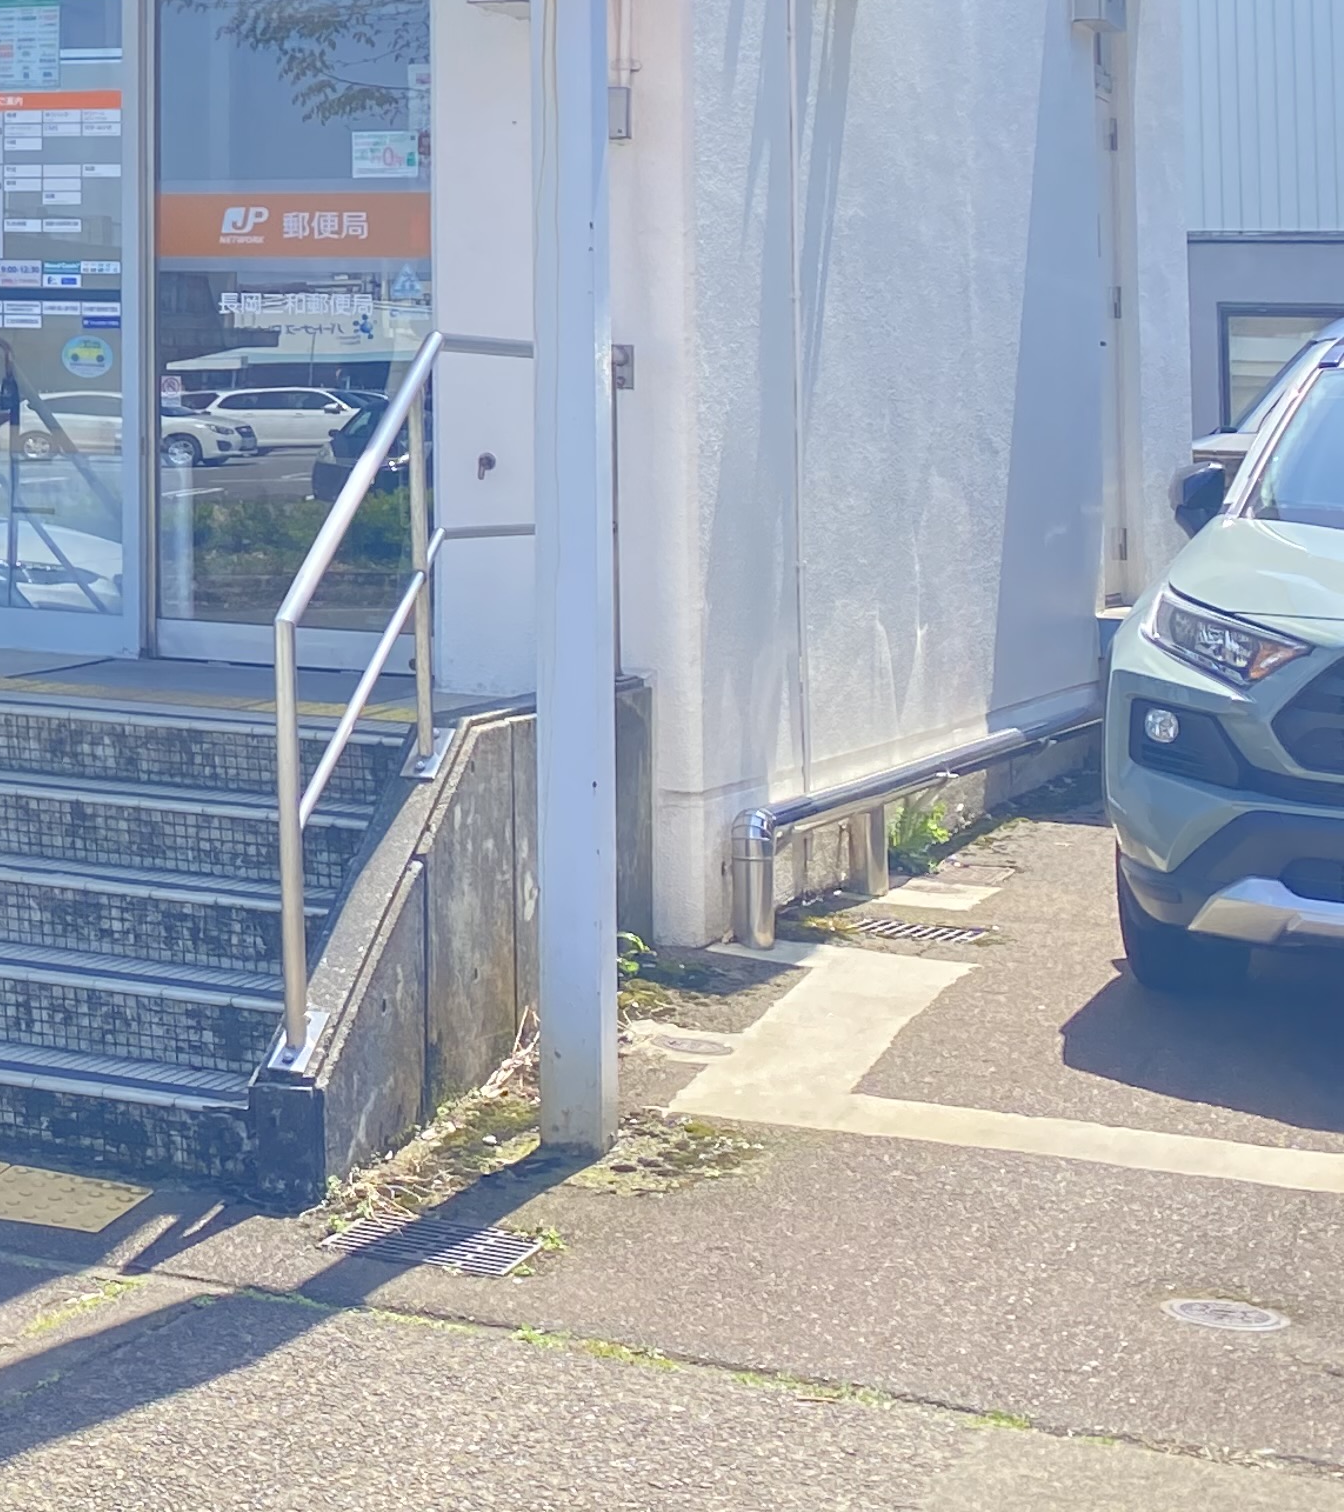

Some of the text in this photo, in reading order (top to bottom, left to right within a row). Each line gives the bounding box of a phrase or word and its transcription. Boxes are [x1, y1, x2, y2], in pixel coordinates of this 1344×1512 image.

[221, 207, 369, 240] JP 郵便局
[218, 292, 374, 316] 長岡三和郵便局
